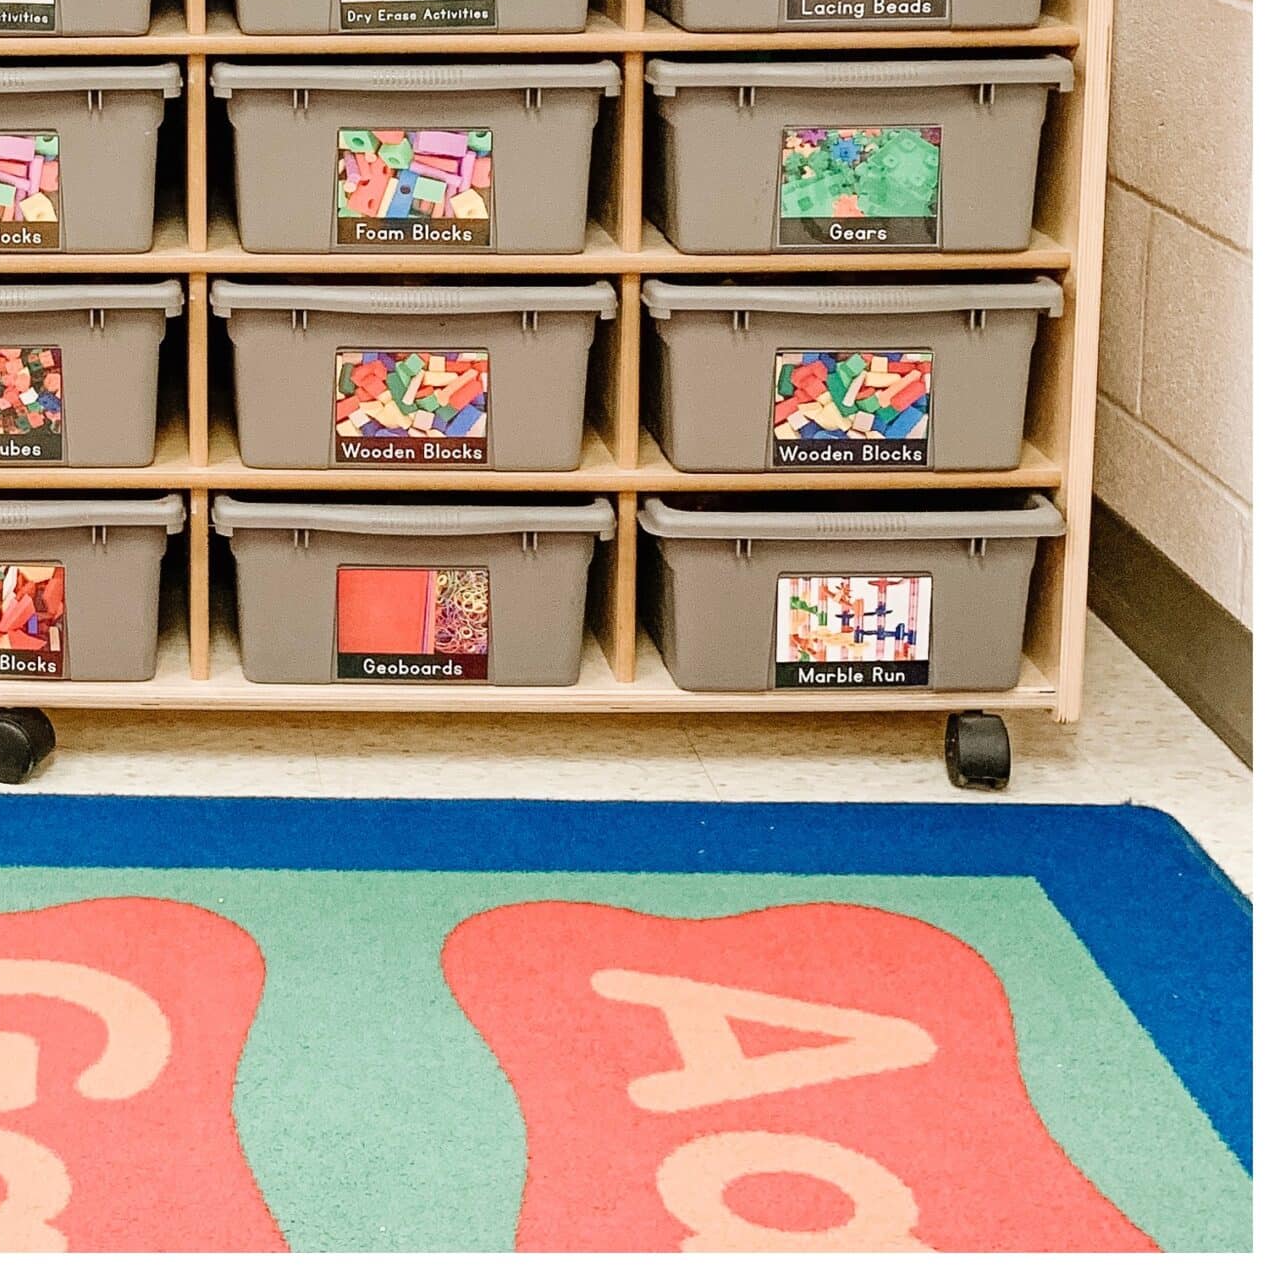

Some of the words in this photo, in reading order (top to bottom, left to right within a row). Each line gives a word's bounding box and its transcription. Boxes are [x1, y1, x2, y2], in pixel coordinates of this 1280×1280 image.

[347, 9, 372, 25] Dry
[378, 7, 417, 23] Erase
[423, 6, 489, 21] Activities
[356, 222, 404, 241] Foam
[412, 223, 472, 242] Blocks
[829, 223, 887, 241] Gears
[341, 442, 415, 459] Wooden
[423, 442, 482, 460] Blocks
[778, 444, 854, 462] Wooden
[862, 444, 922, 462] Blocks
[363, 658, 463, 676] Geoboards
[798, 666, 864, 684] Marble
[872, 666, 906, 683] Run
